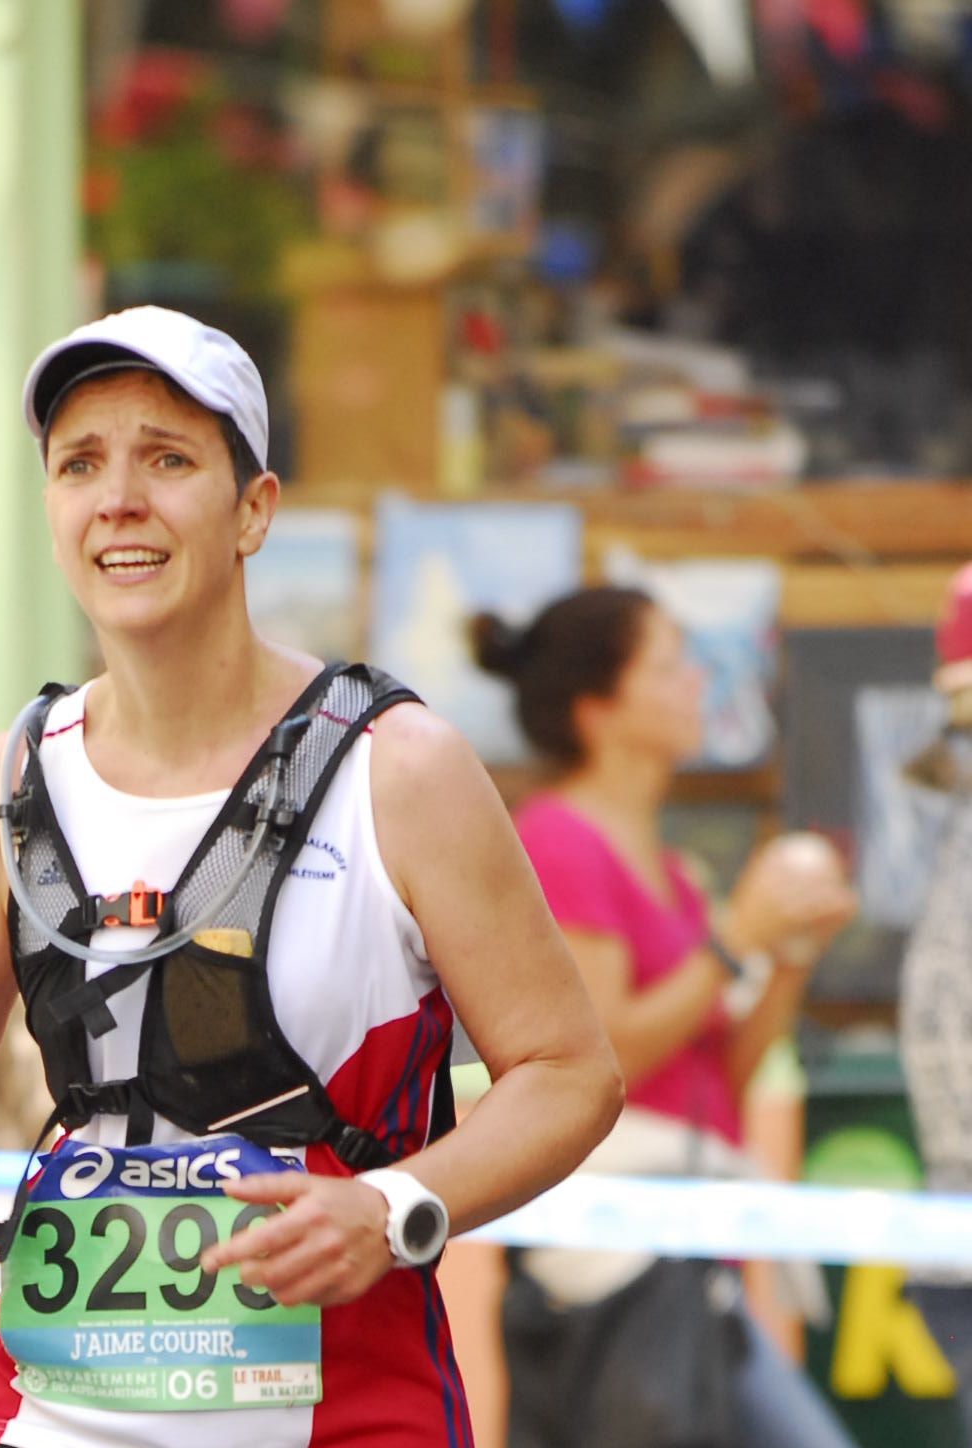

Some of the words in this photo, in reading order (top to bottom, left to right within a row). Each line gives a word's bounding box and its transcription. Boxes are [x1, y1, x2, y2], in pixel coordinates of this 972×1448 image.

[304, 837, 348, 872] ALAKOFF
[120, 1148, 241, 1190] asics
[71, 1332, 145, 1360] J'AIME
[168, 1370, 218, 1400] 06
[234, 1371, 246, 1384] LE
